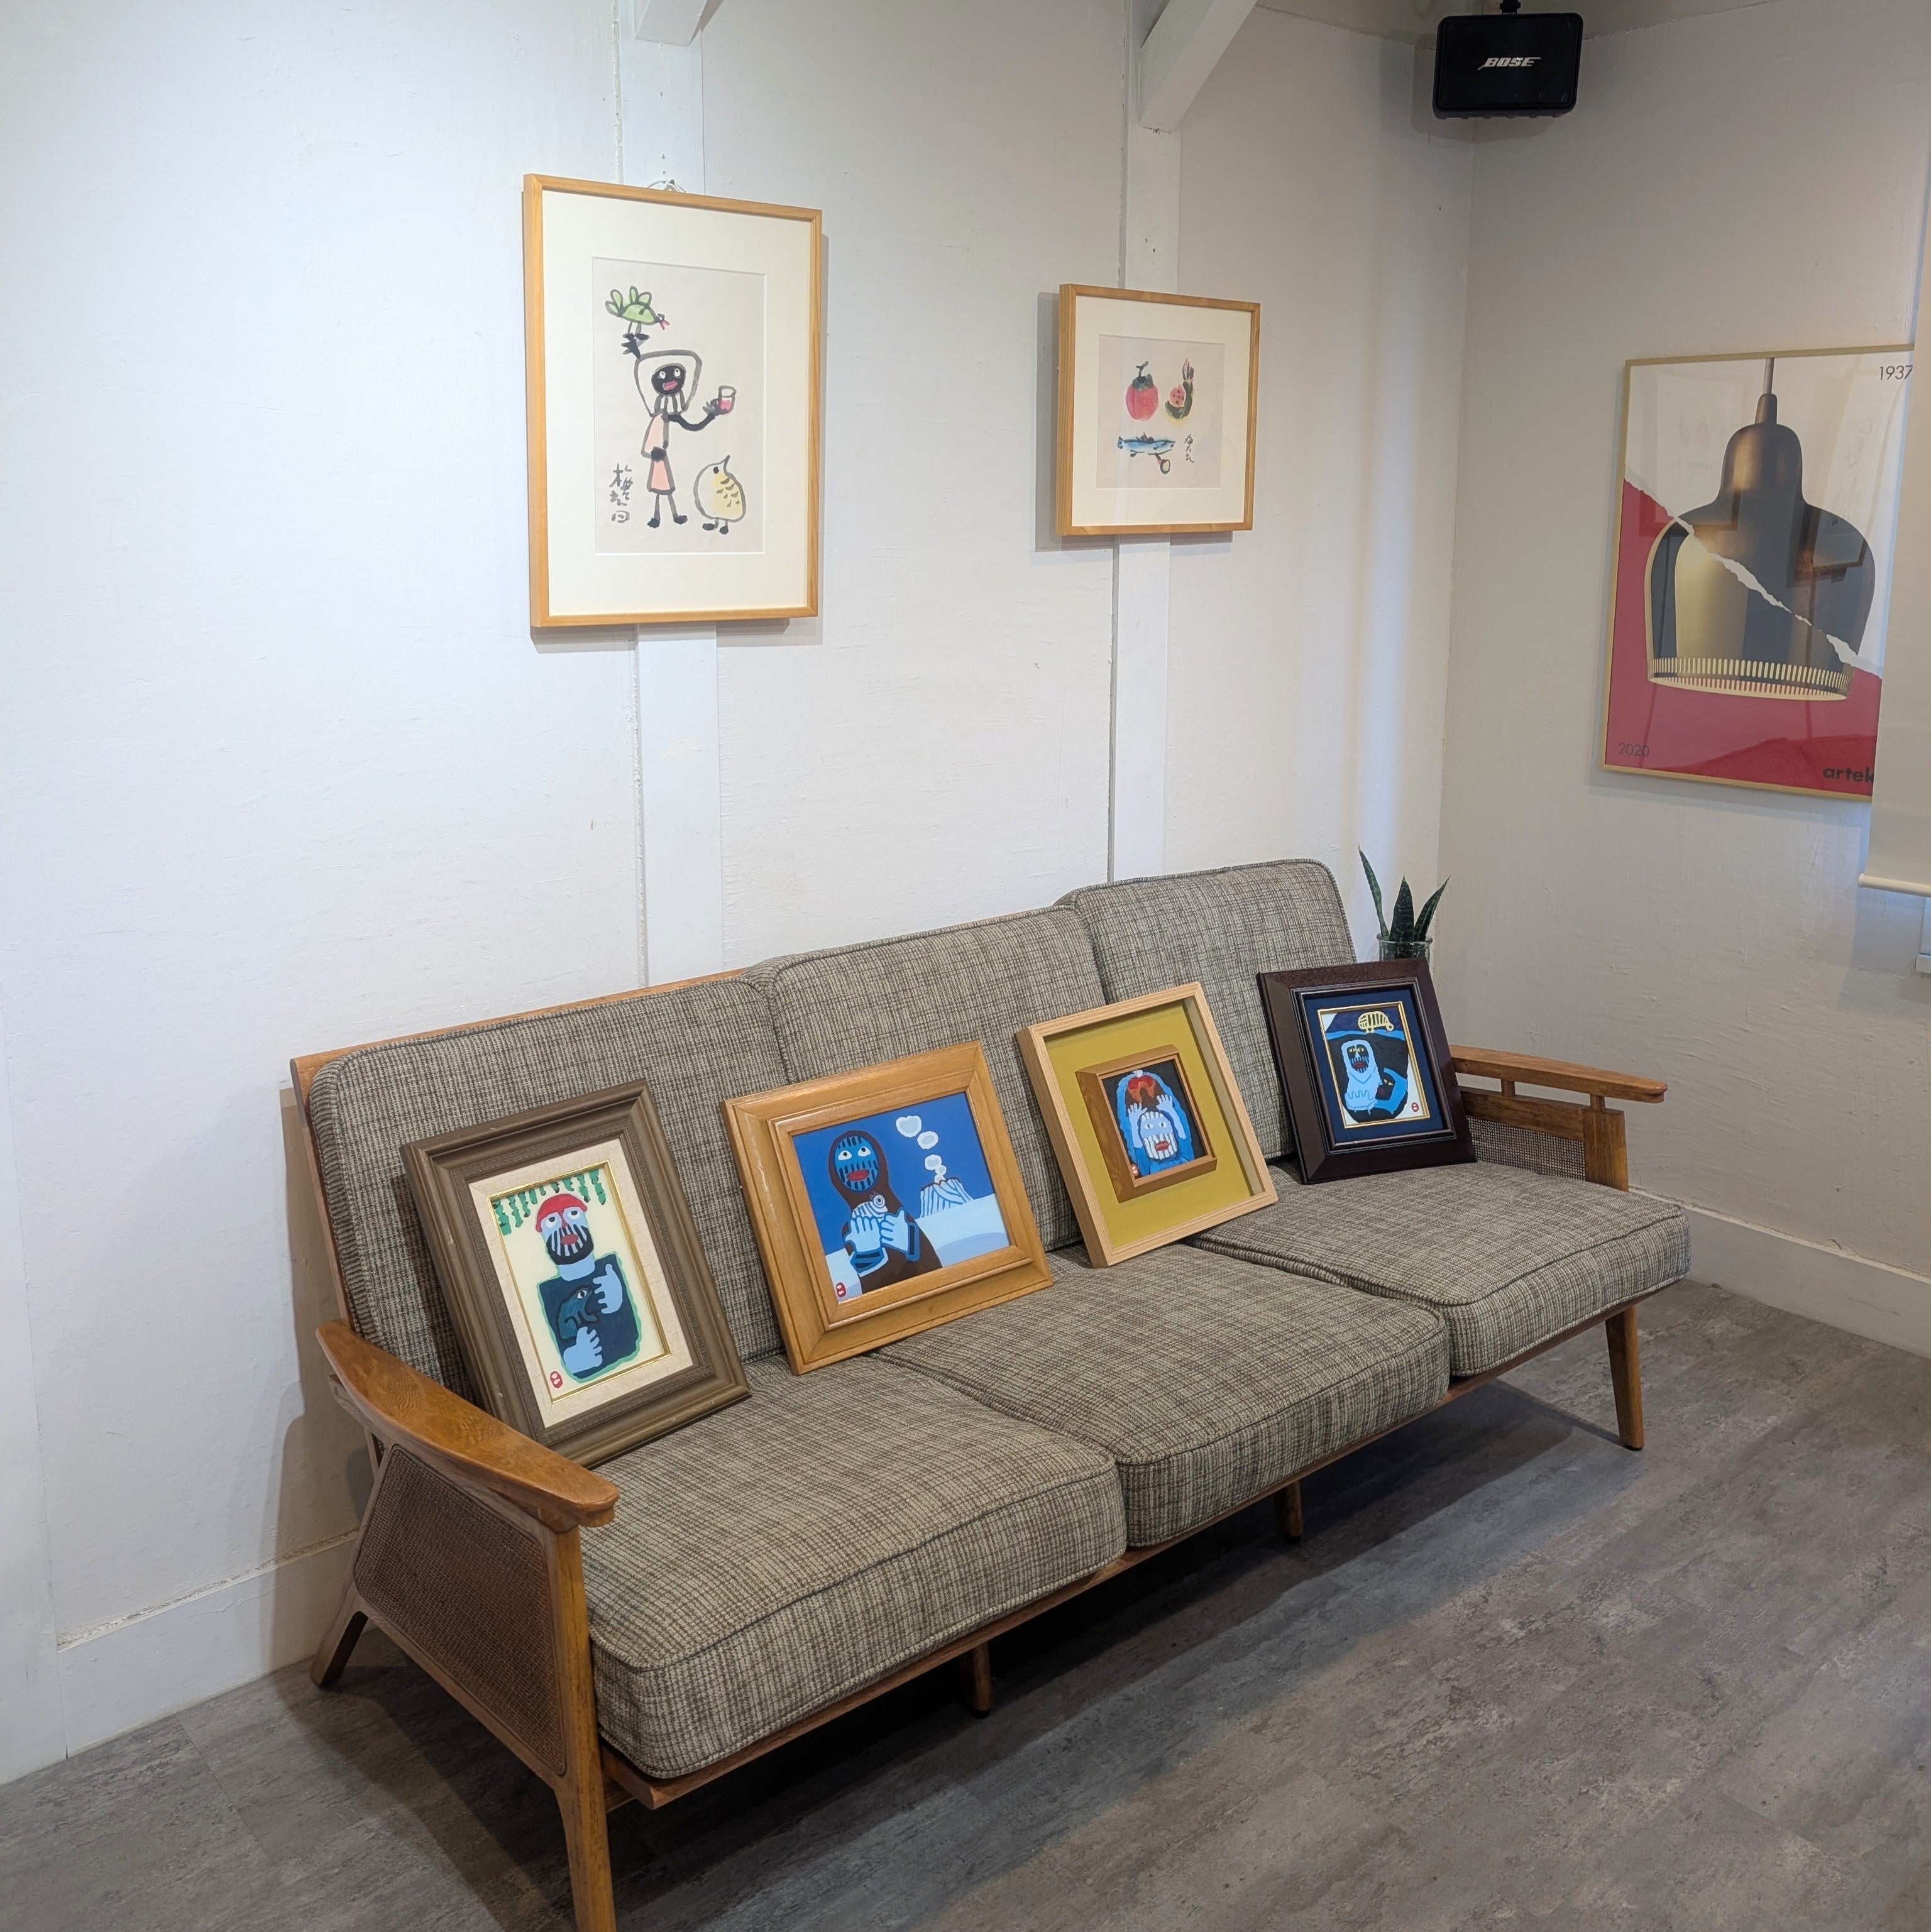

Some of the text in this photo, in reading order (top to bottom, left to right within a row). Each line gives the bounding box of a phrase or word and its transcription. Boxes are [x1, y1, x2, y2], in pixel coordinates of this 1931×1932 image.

[1478, 57, 1541, 70] BOSE
[1879, 365, 1913, 380] 1937
[1619, 742, 1649, 757] 2020
